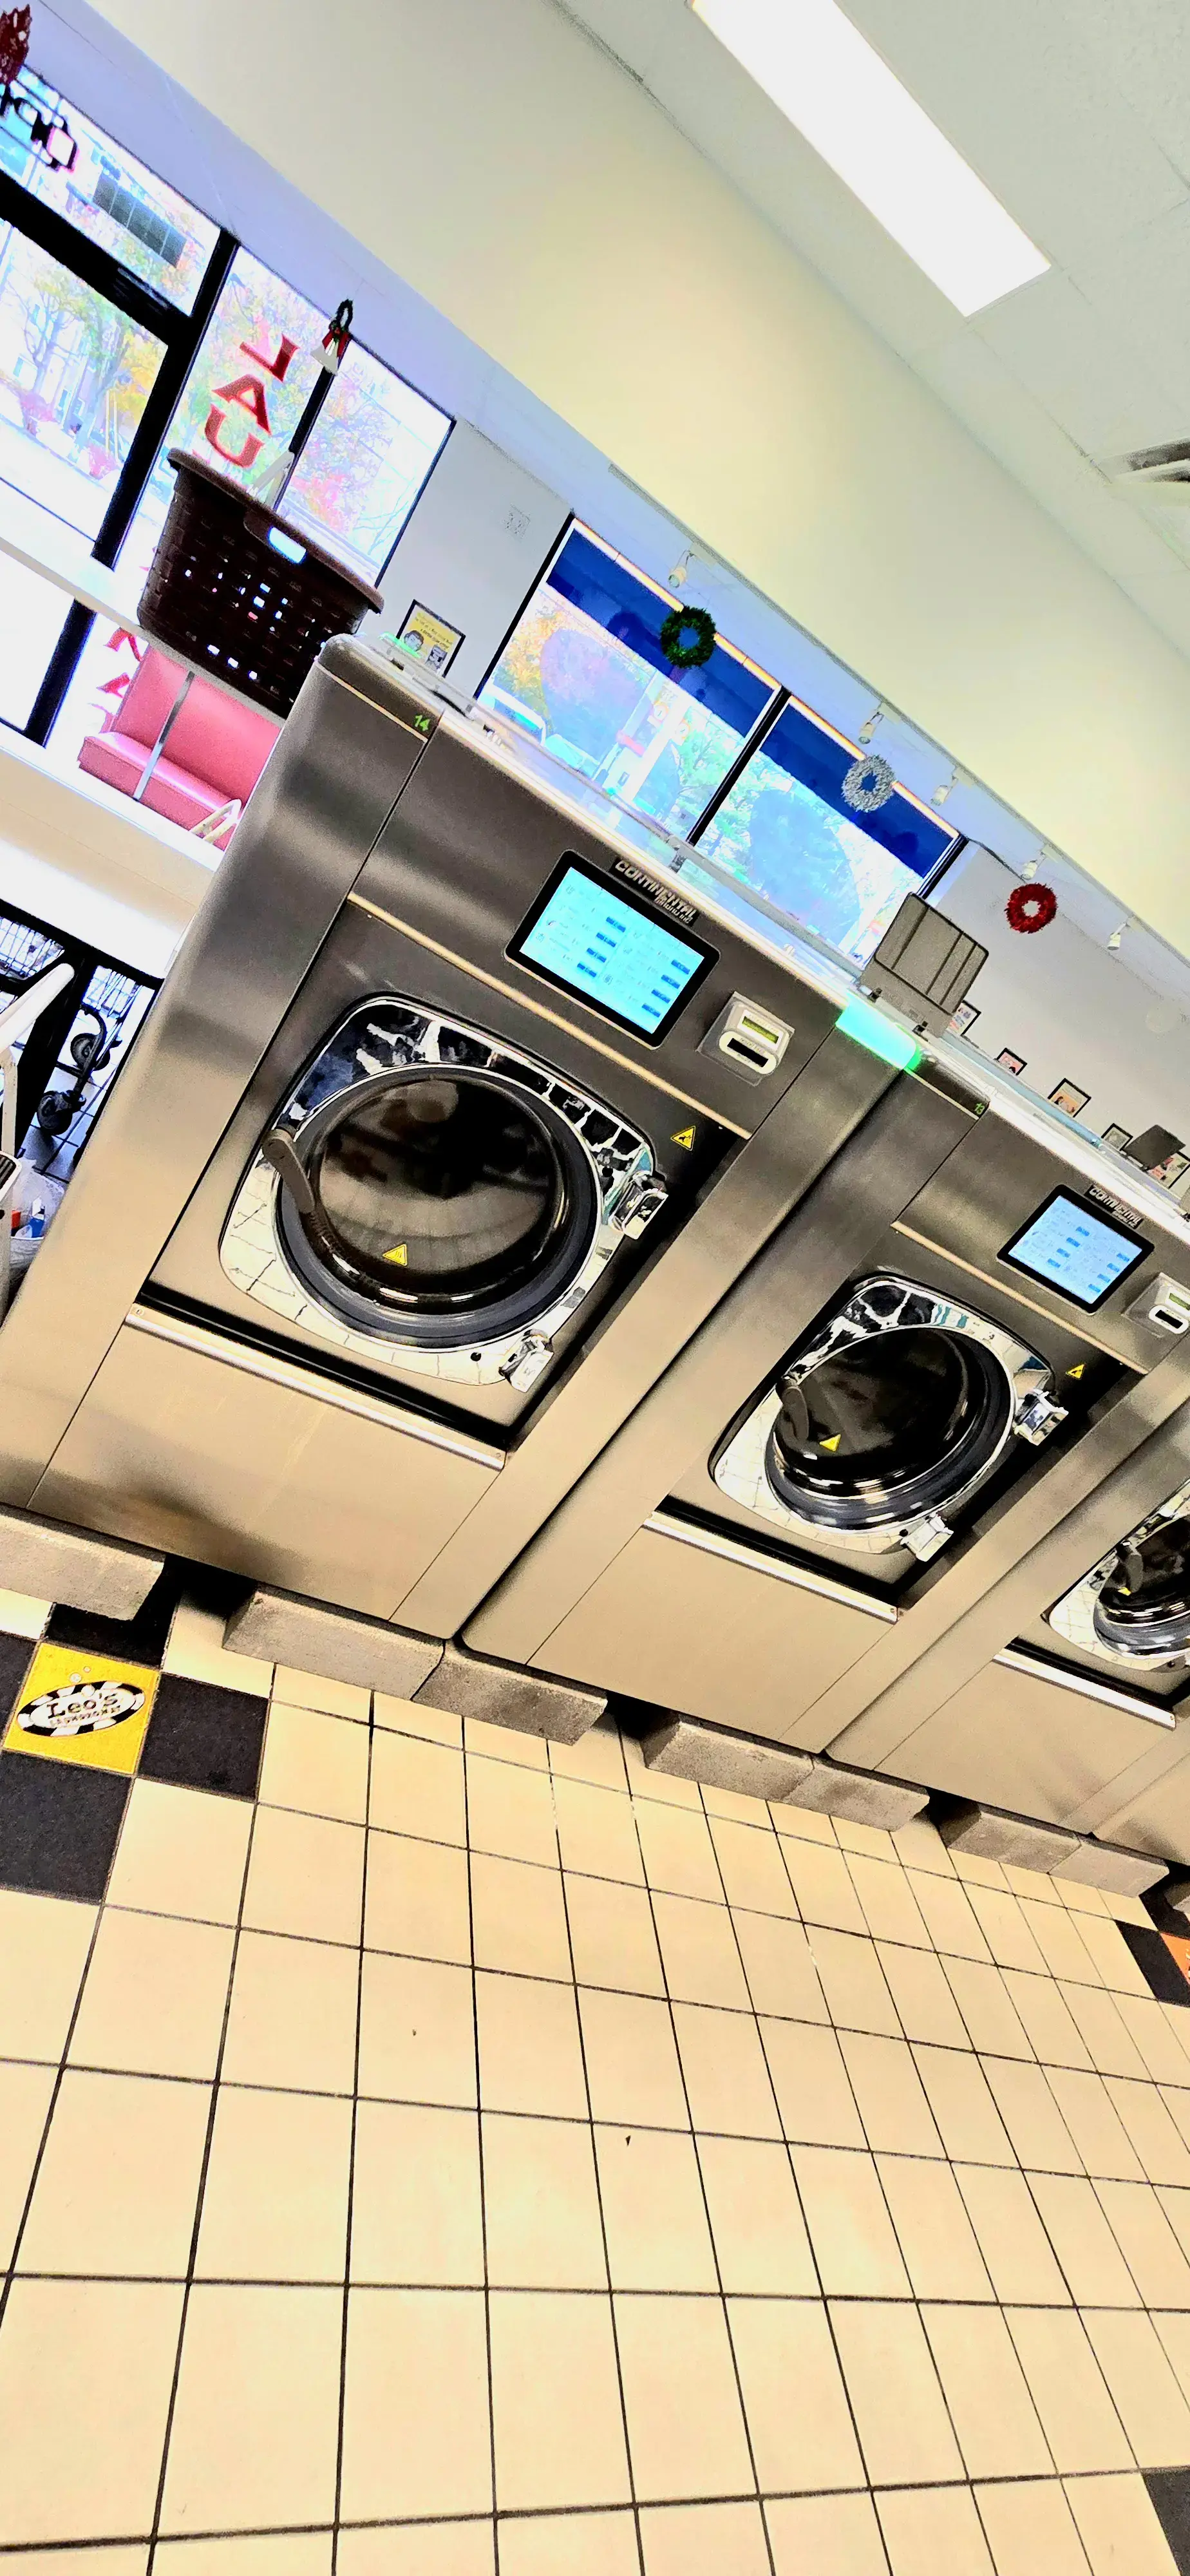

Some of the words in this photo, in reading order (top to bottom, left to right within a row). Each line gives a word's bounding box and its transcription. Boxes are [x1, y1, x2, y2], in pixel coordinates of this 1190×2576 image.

[413, 713, 429, 732] 14
[974, 1102, 986, 1115] 13
[46, 1692, 118, 1718] Leo's
